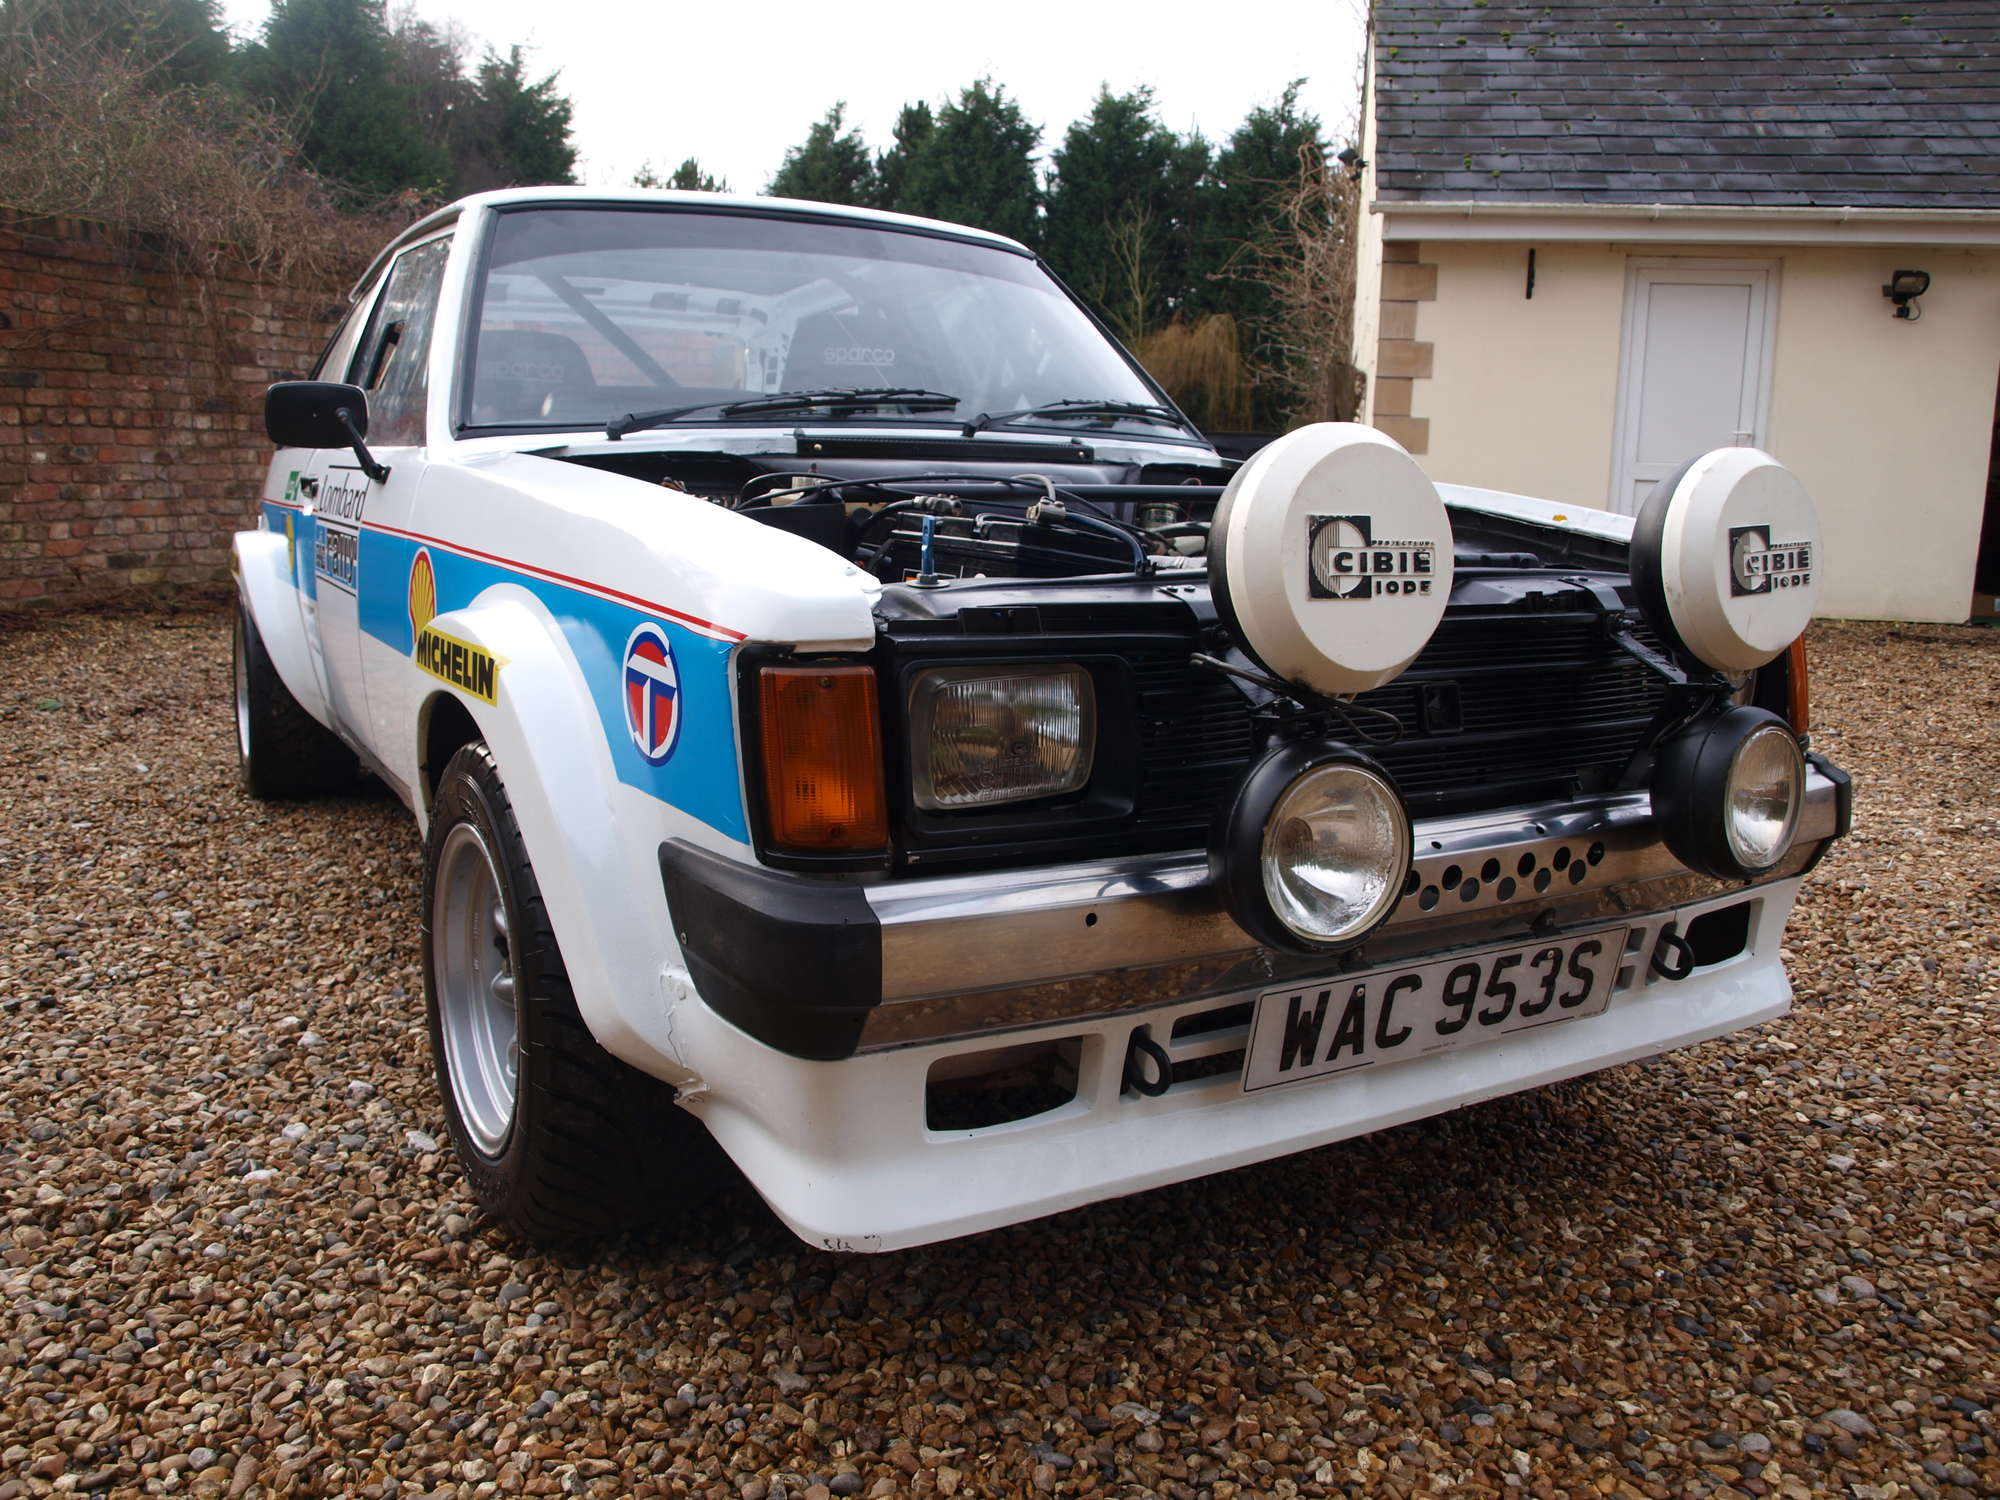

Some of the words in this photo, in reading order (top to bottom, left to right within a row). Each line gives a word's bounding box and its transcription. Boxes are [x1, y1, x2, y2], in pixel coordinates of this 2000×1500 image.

[824, 347, 896, 366] sparco
[319, 472, 371, 521] Lombard
[1376, 580, 1432, 595] IODE
[1774, 574, 1810, 589] IODE
[417, 630, 496, 699] MICHELIN
[1279, 973, 1423, 1072] WAC
[1435, 940, 1602, 1036] 953S
